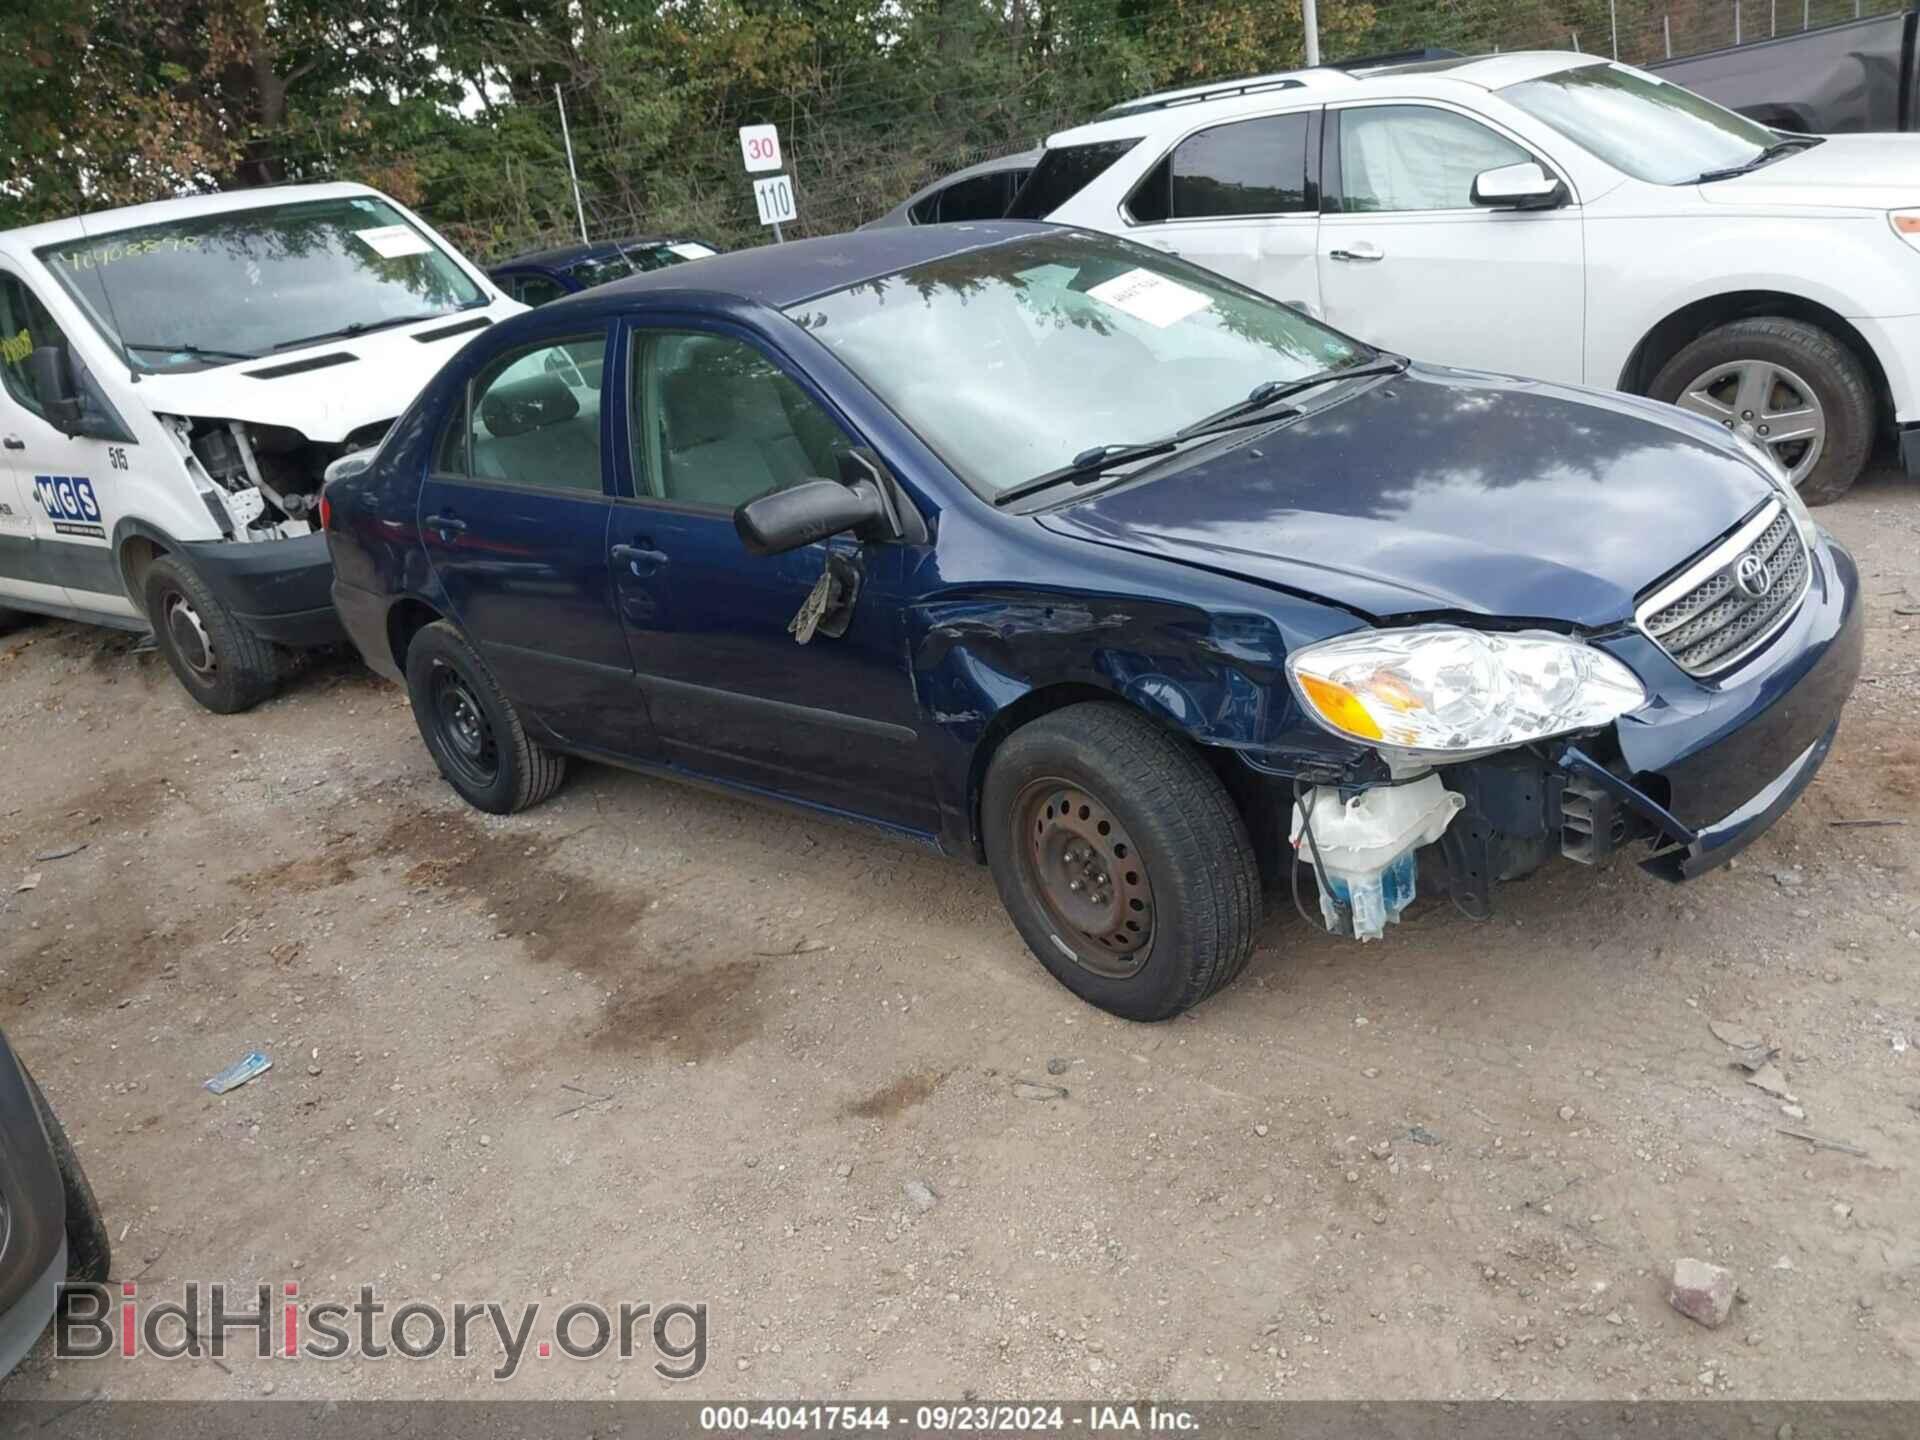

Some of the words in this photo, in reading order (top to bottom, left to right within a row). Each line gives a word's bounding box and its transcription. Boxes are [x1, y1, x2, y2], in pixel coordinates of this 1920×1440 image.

[748, 137, 774, 160] 30
[759, 181, 791, 219] 110
[108, 447, 129, 471] 515
[37, 481, 98, 517] MGS
